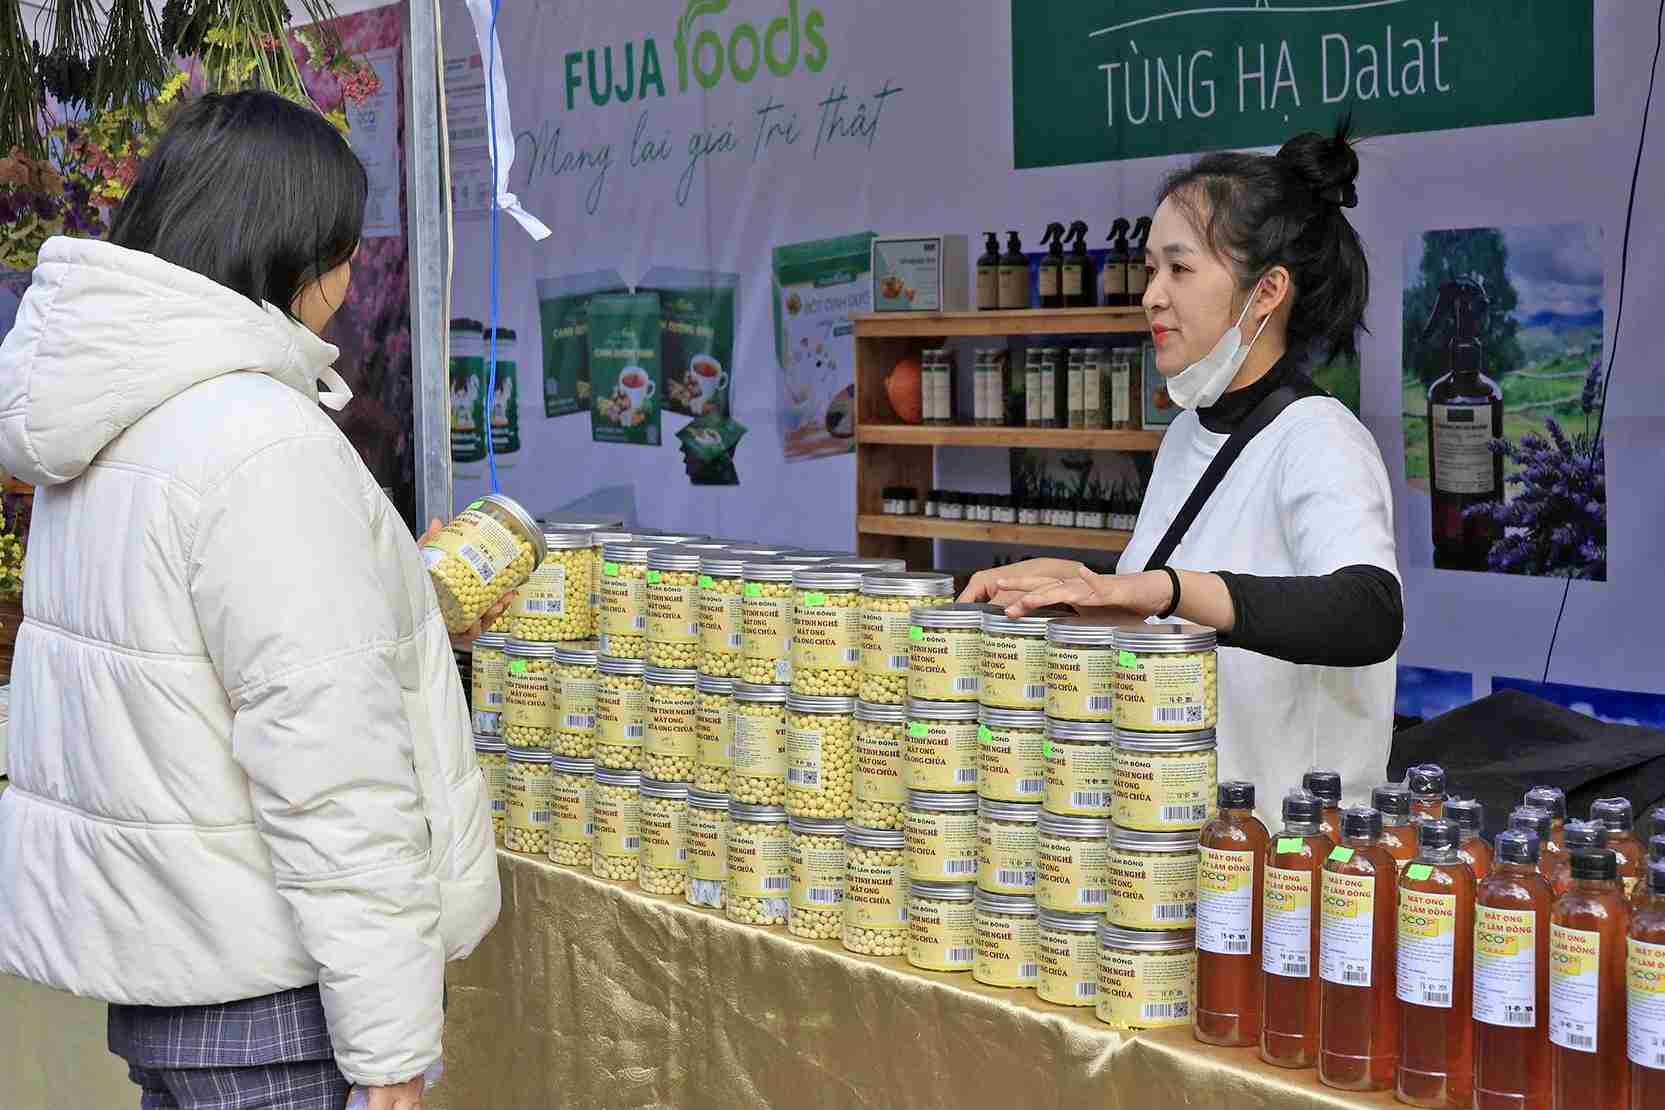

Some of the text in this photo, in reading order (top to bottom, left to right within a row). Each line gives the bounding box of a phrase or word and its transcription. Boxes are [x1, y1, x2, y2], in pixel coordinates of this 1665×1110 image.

[564, 0, 829, 110] FUJA foods
[1098, 21, 1450, 127] TÙNG HẠ Dalat
